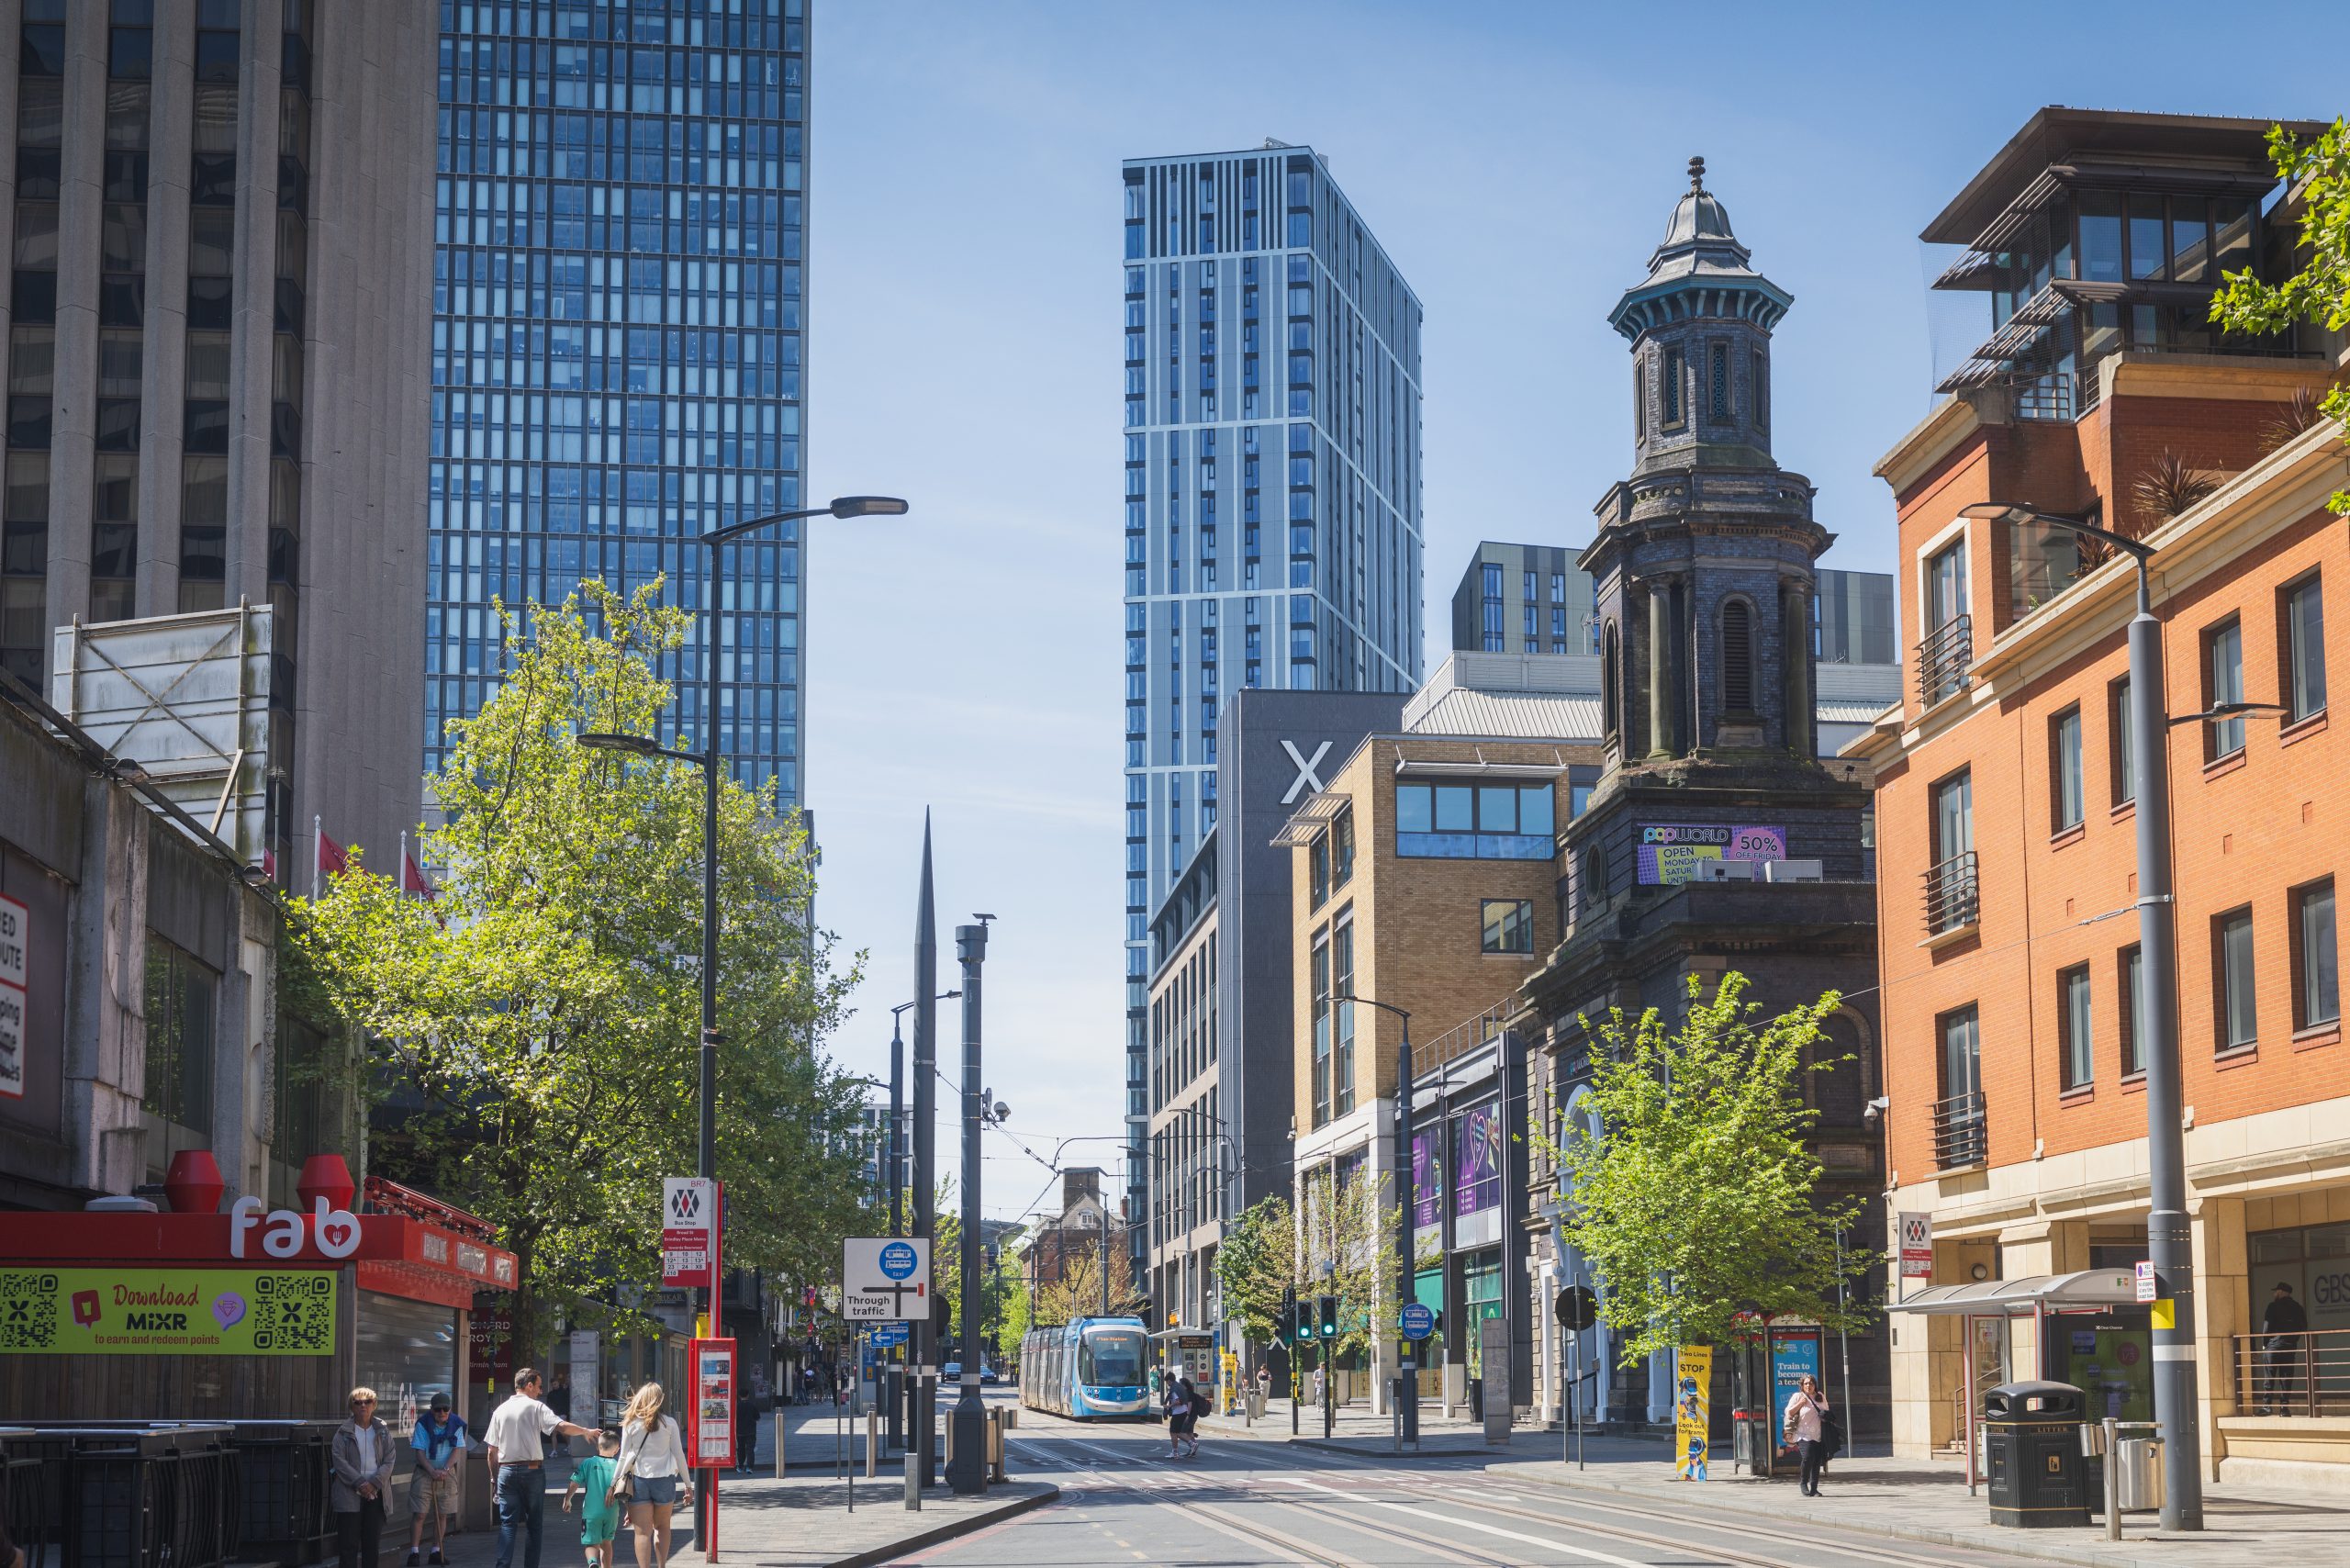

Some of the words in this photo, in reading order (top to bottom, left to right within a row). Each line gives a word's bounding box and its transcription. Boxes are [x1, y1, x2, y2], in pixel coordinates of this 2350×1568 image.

[1740, 836, 1777, 852] 50%
[1663, 847, 1695, 858] OPEN
[1664, 857, 1700, 867] MONDAY
[1665, 867, 1692, 876] SATUR
[0, 912, 16, 937] ED
[0, 942, 21, 970] UTE
[230, 1195, 362, 1259] fab
[113, 1283, 199, 1307] Download
[847, 1296, 890, 1305] Through
[853, 1307, 885, 1316] traffic
[126, 1313, 187, 1330] MiXR
[95, 1335, 104, 1344] to
[106, 1336, 129, 1344] earn
[131, 1334, 149, 1344] and
[151, 1335, 187, 1345] redeem
[190, 1335, 219, 1346] points
[1680, 1364, 1705, 1372] STOP
